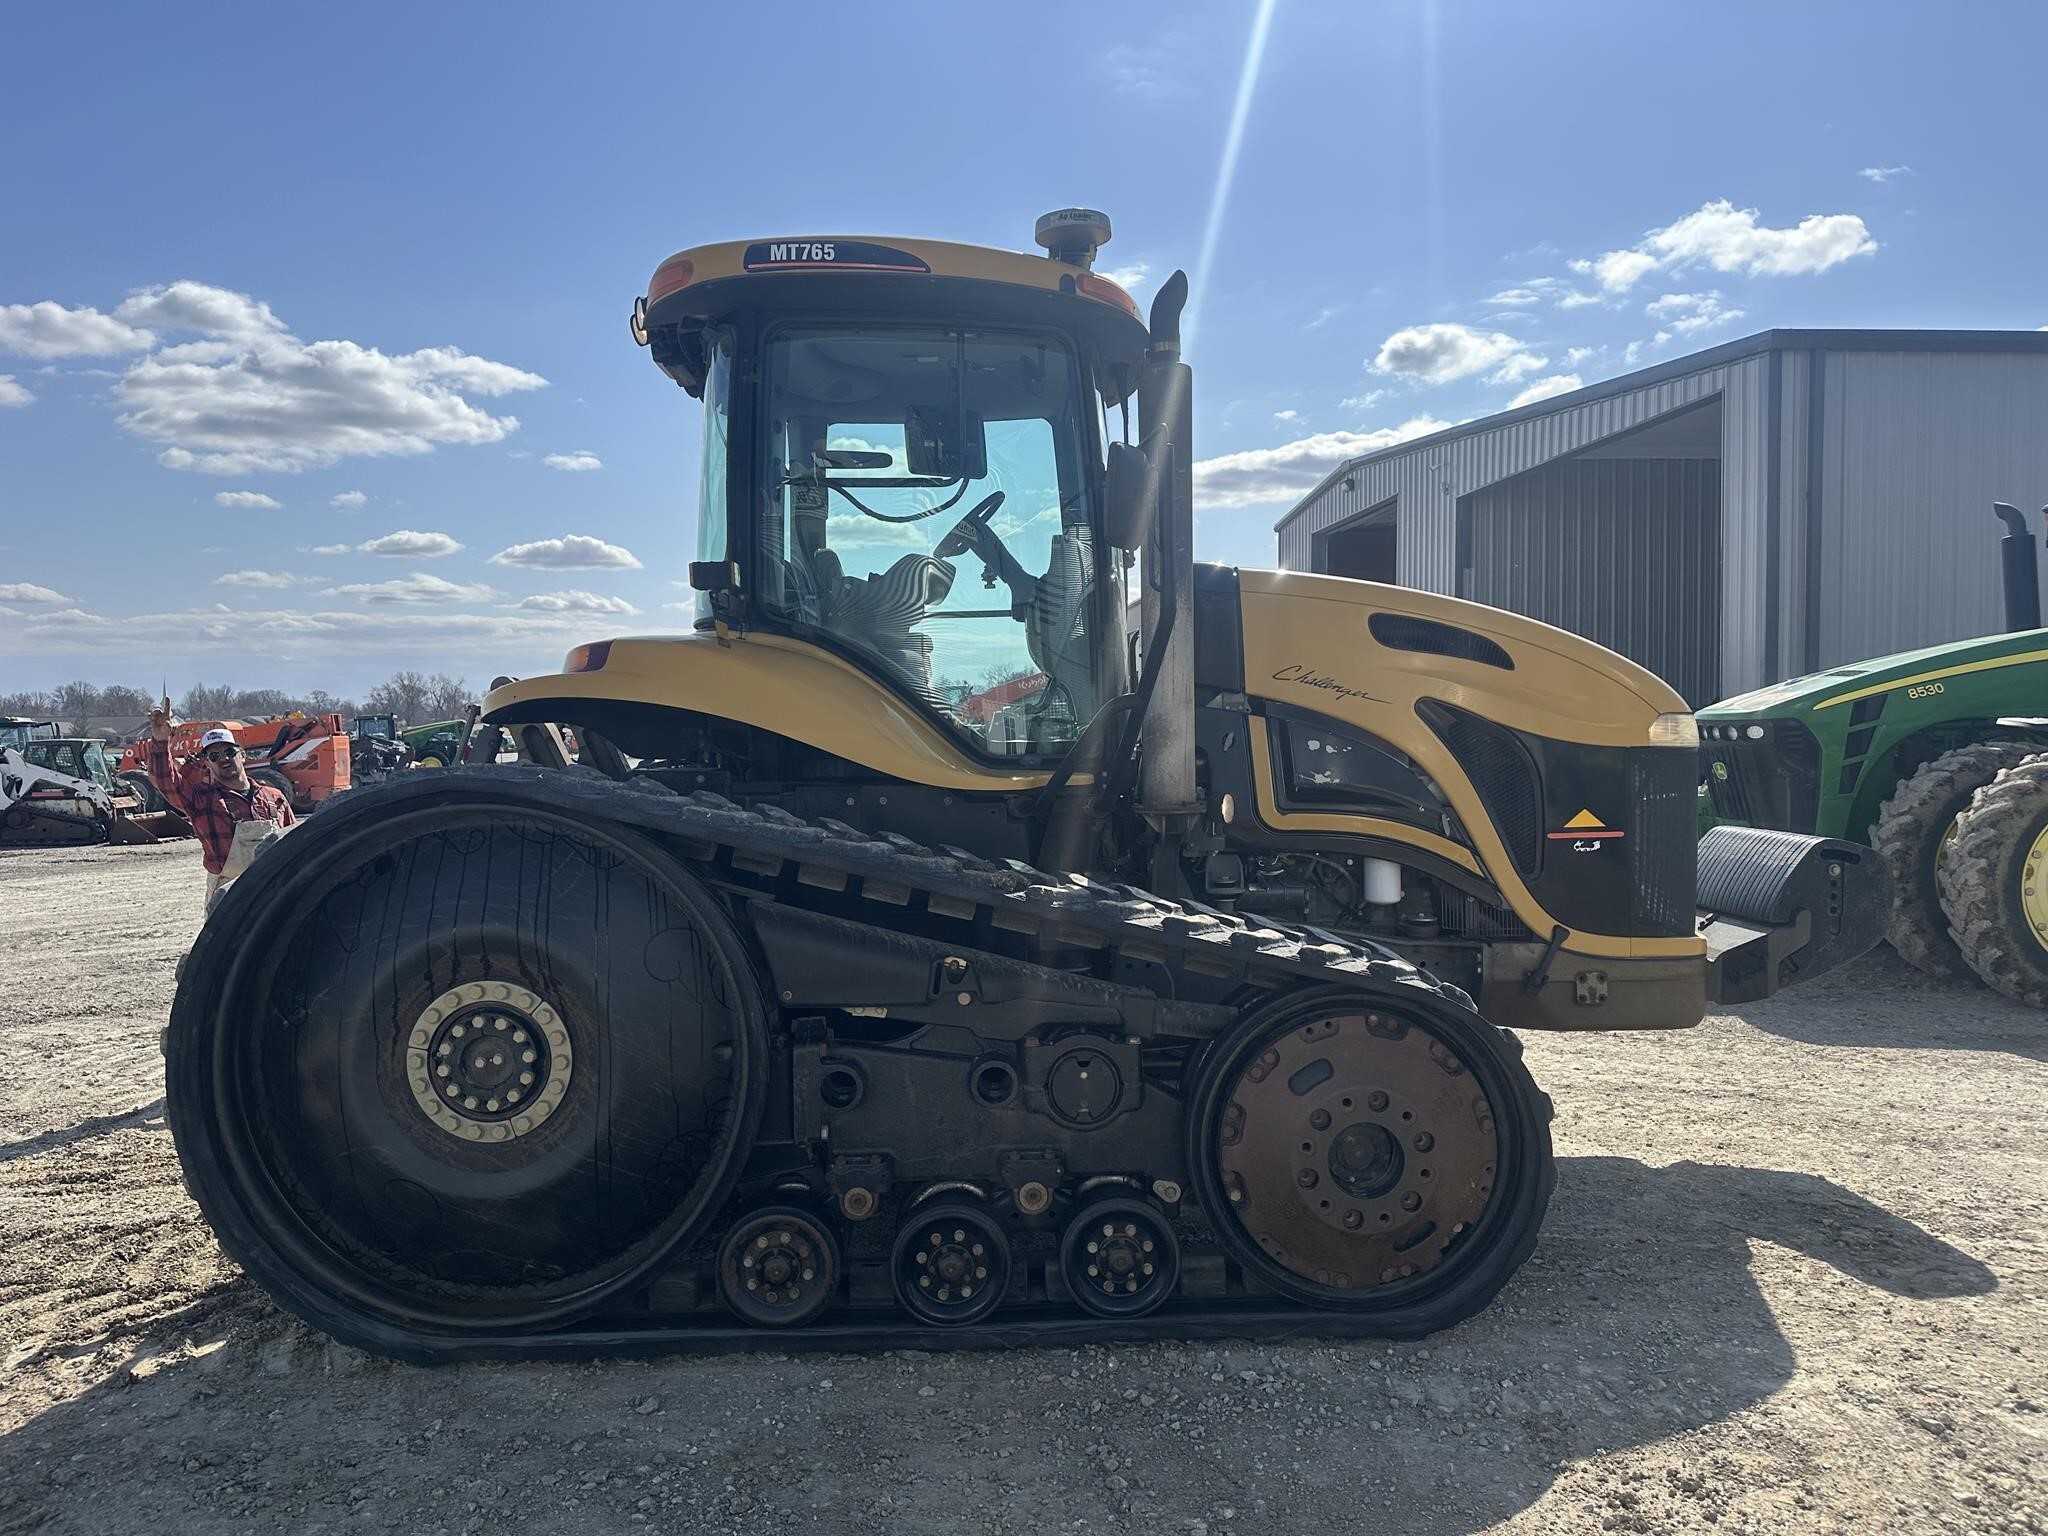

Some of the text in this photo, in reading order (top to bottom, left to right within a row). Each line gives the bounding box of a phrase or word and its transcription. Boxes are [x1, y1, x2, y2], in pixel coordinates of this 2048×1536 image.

[770, 243, 835, 261] MT765
[1017, 675, 1047, 689] Kubot
[1272, 665, 1393, 704] Challenger
[1907, 682, 1945, 699] 8530
